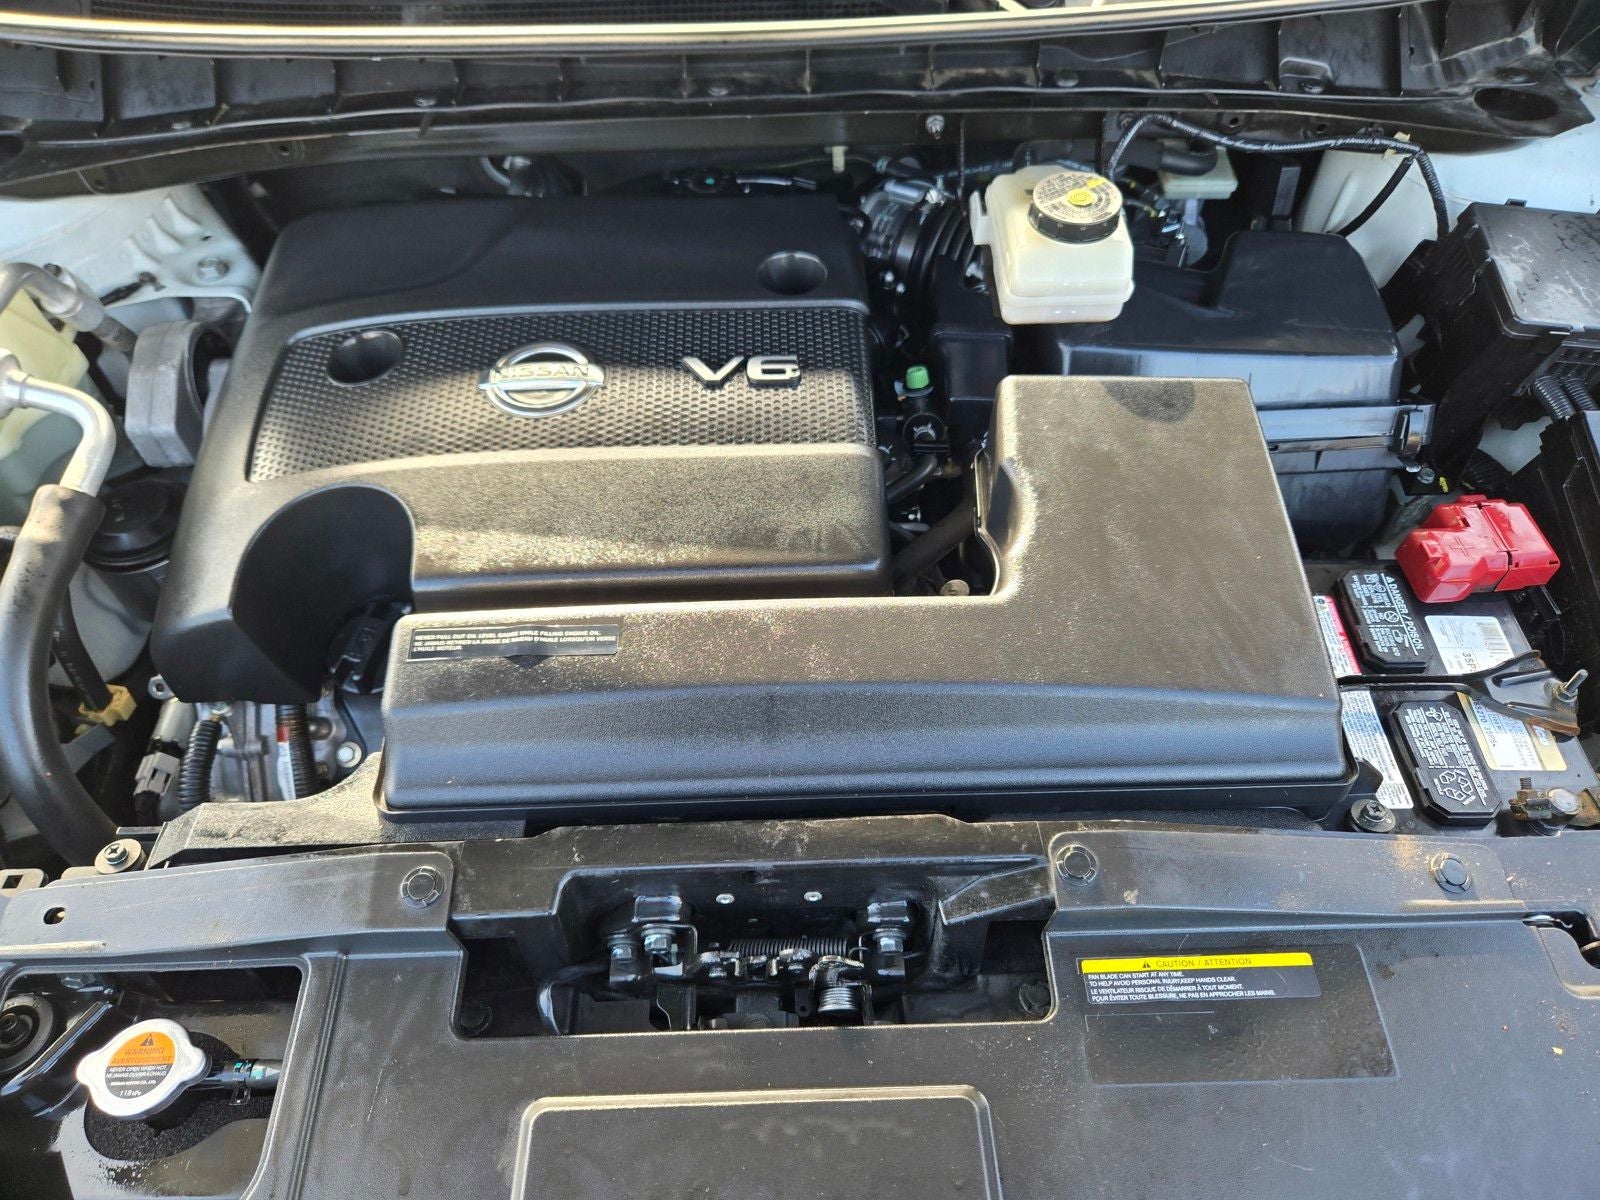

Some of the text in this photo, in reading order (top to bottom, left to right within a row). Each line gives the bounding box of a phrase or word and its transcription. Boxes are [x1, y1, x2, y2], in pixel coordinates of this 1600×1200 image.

[493, 365, 589, 379] NISSAN
[680, 355, 801, 389] V6
[1389, 583, 1409, 614] DANGER
[1405, 620, 1425, 650] POISON
[1156, 960, 1194, 968] CAUTION
[1204, 958, 1252, 966] ATTENTION
[125, 1048, 164, 1056] WARNING
[111, 1056, 172, 1064] AVERTISSEMENT
